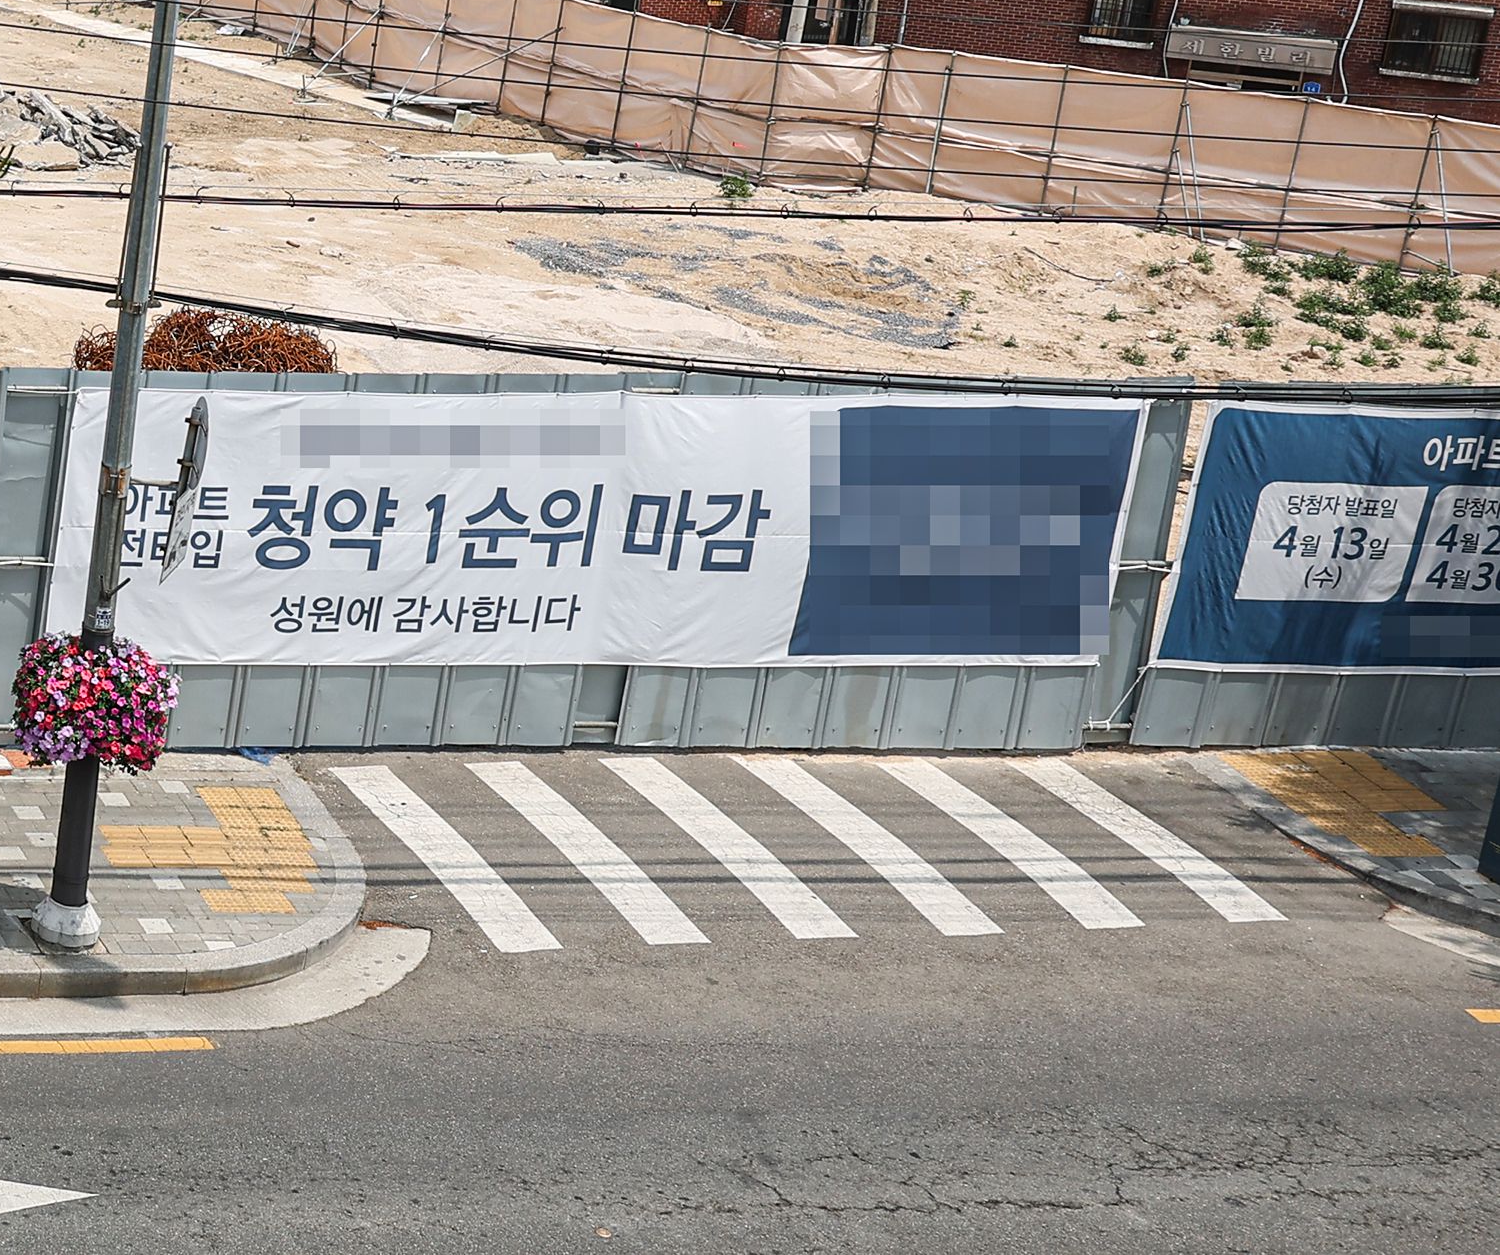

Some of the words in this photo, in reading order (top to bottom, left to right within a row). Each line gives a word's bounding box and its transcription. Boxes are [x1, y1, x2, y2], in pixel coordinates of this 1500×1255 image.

[1287, 494, 1341, 516] 당첨자
[1344, 496, 1399, 519] 발표일
[1452, 497, 1500, 519] 당첨자
[247, 484, 399, 572] 청약
[424, 483, 605, 570] 1순위
[621, 488, 772, 572] 마감
[1272, 525, 1321, 558] 4월
[1330, 525, 1390, 560] 13일
[1434, 523, 1480, 554] 4월
[1304, 565, 1342, 589] (수)
[1425, 560, 1470, 590] 4월
[1471, 561, 1500, 592] 3
[269, 595, 384, 634] 성원에
[391, 593, 582, 634] 감사합니다
